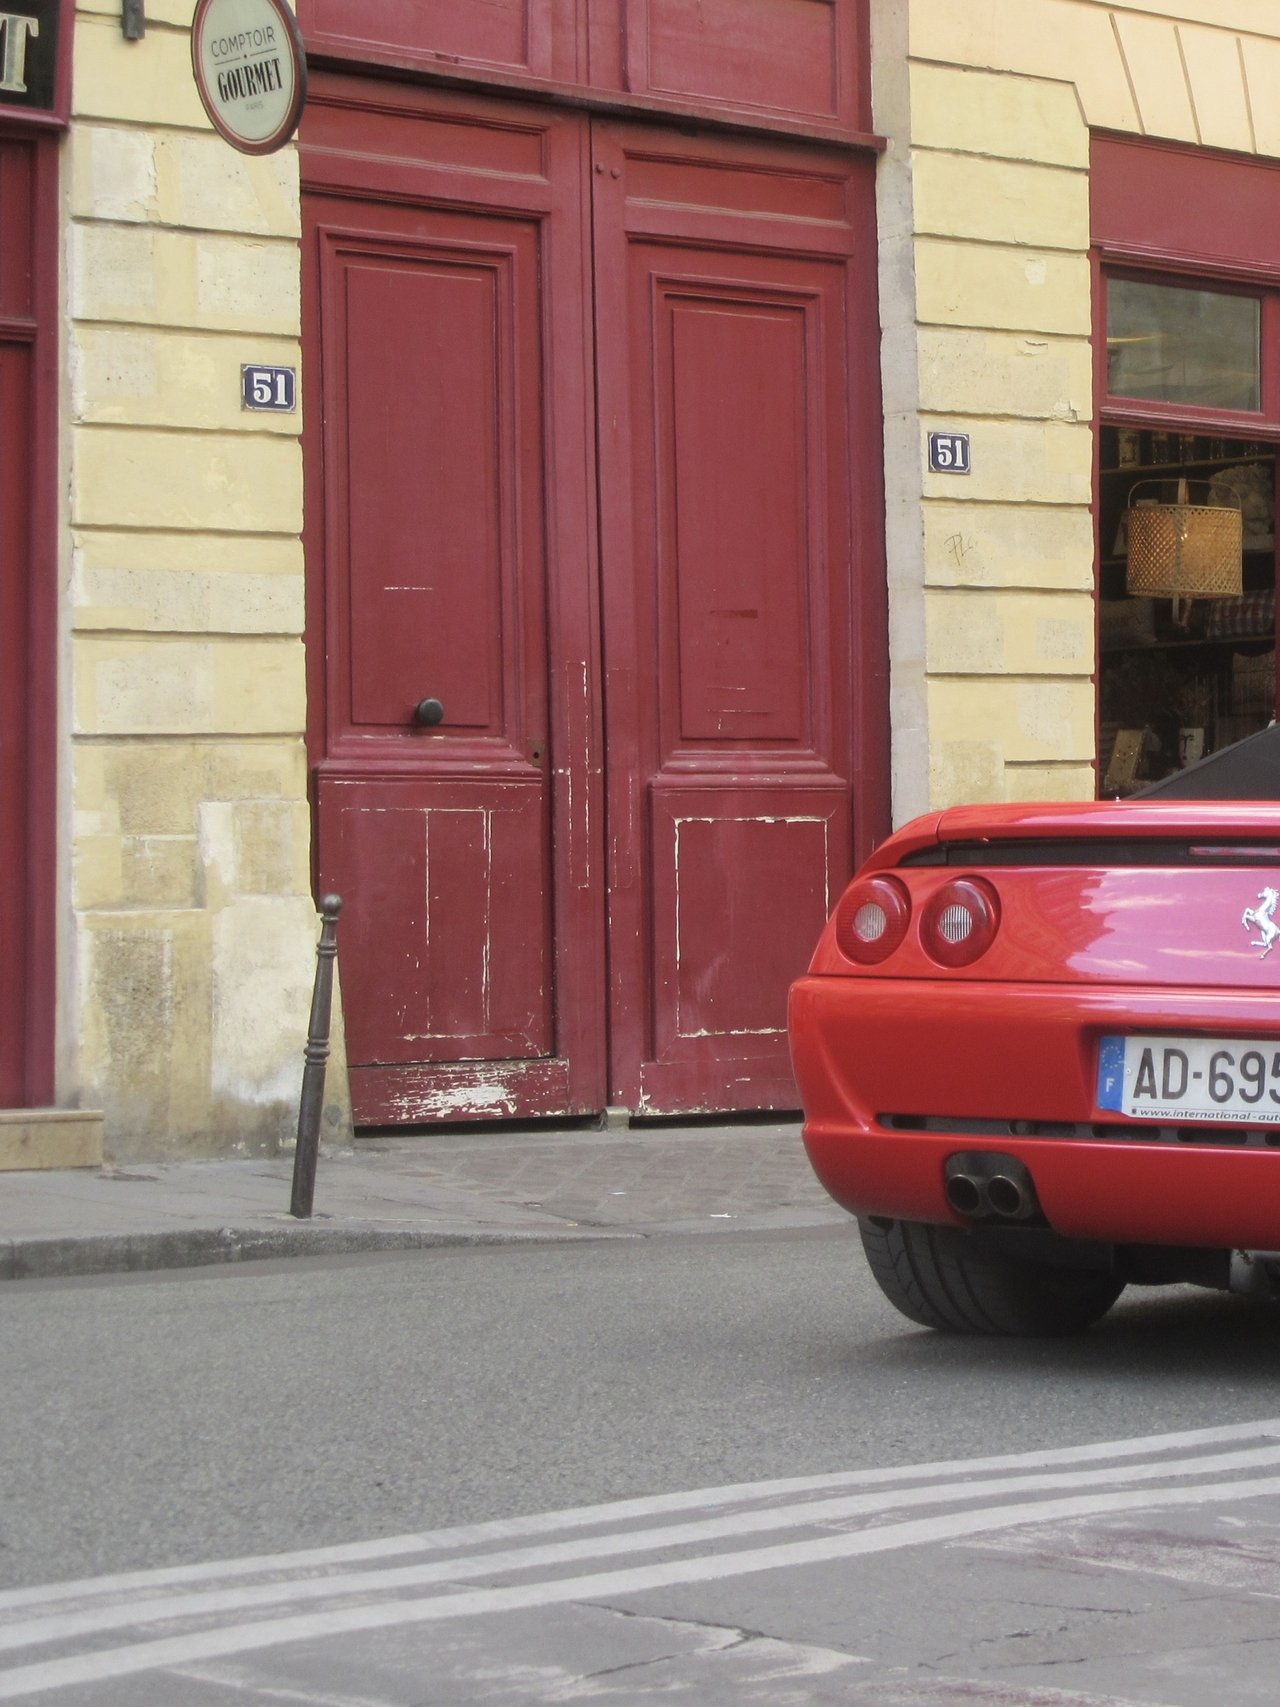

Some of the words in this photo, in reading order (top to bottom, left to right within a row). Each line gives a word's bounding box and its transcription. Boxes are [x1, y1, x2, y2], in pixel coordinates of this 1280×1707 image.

[211, 26, 276, 57] COMPTOIR
[217, 58, 283, 103] GOURMET
[246, 101, 264, 112] PARIS
[253, 372, 288, 405] 51
[937, 438, 965, 467] 51
[1105, 1078, 1115, 1092] F
